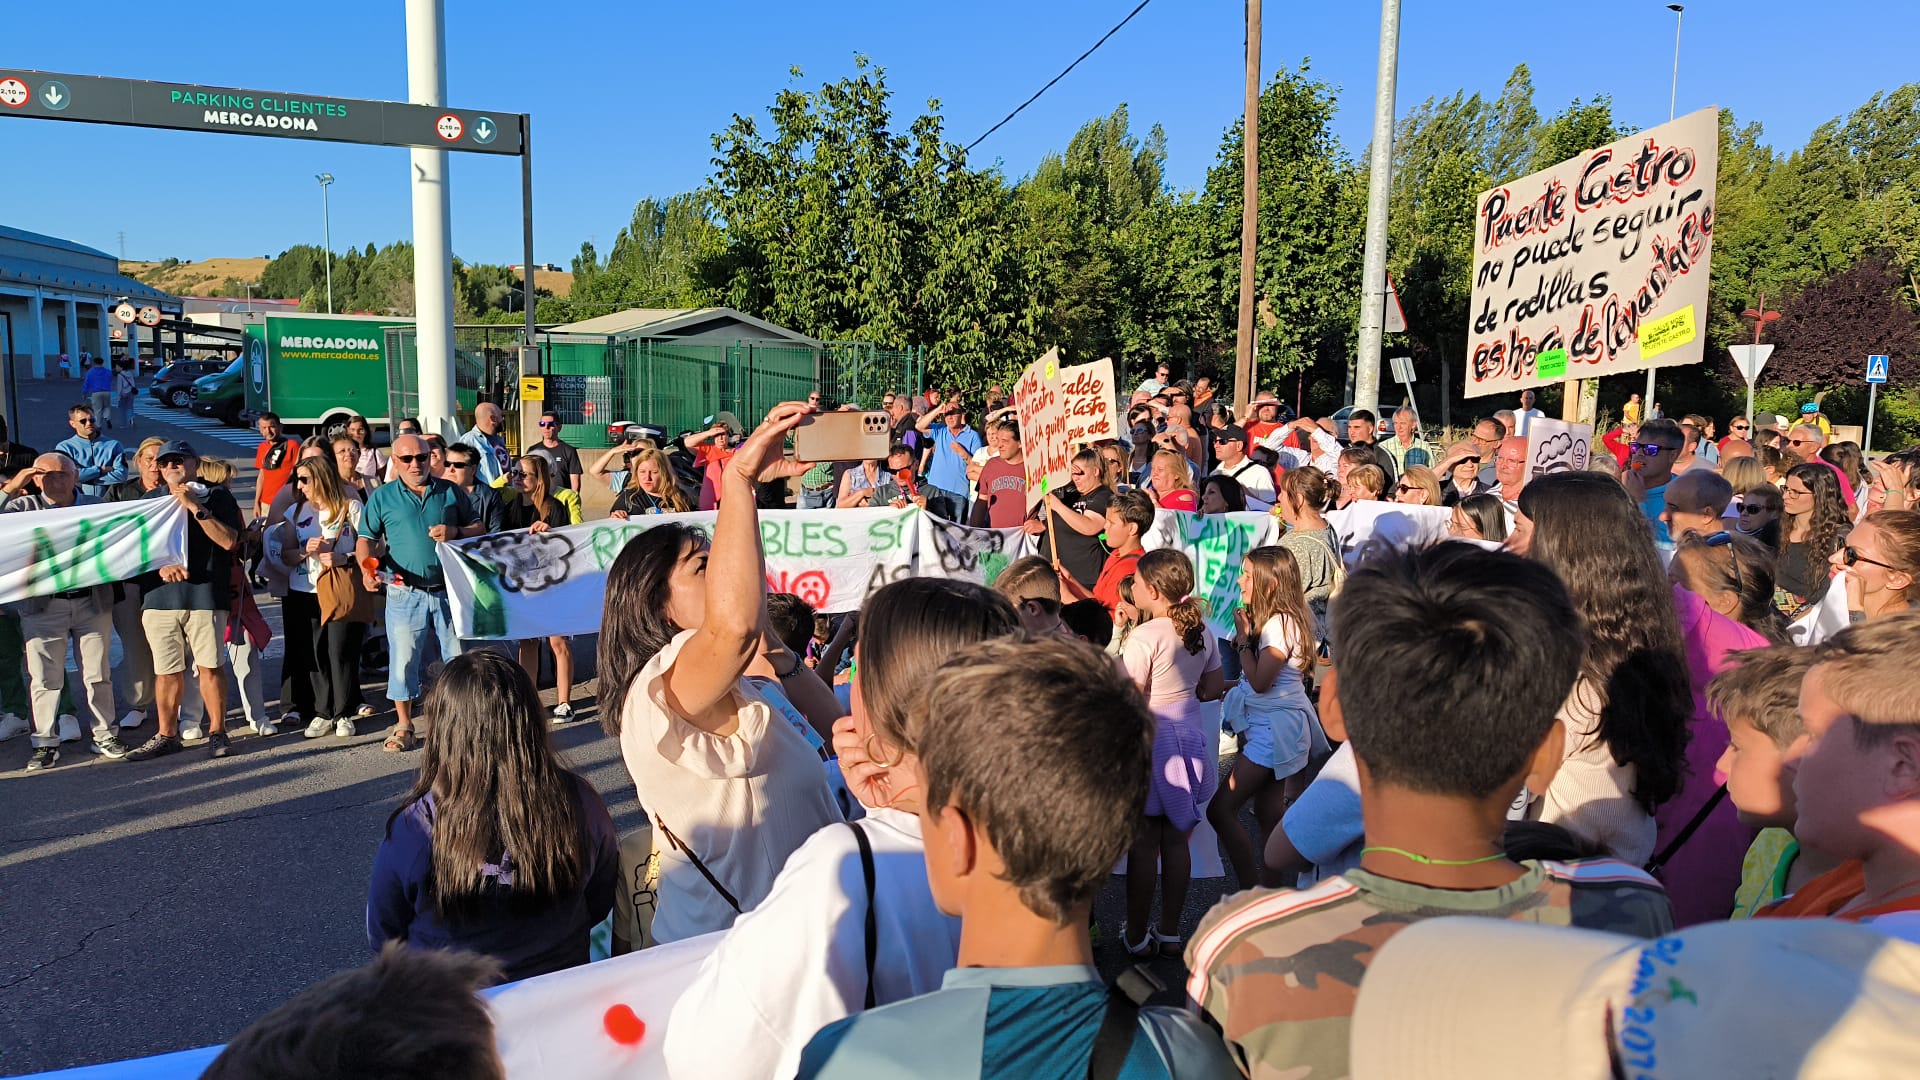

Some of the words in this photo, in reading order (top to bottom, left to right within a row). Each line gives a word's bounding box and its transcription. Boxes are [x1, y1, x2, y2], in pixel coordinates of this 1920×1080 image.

[171, 90, 254, 110] PARKING
[260, 98, 347, 117] CLIENTES
[204, 110, 318, 132] MERCADONA
[1481, 178, 1567, 253] Puente
[1575, 139, 1696, 213] Castro
[1476, 258, 1503, 290] no
[1507, 216, 1585, 289] puede
[1592, 189, 1703, 263] seguir
[1474, 296, 1497, 335] de
[1503, 267, 1609, 323] rodillas
[280, 335, 379, 350] MERCADONA
[281, 351, 380, 360] www.mercadona.es
[1472, 339, 1505, 383] es
[1570, 304, 1603, 364] de
[1073, 395, 1107, 416] Castro
[1067, 425, 1086, 443] que
[1622, 1007, 1656, 1080] 201
